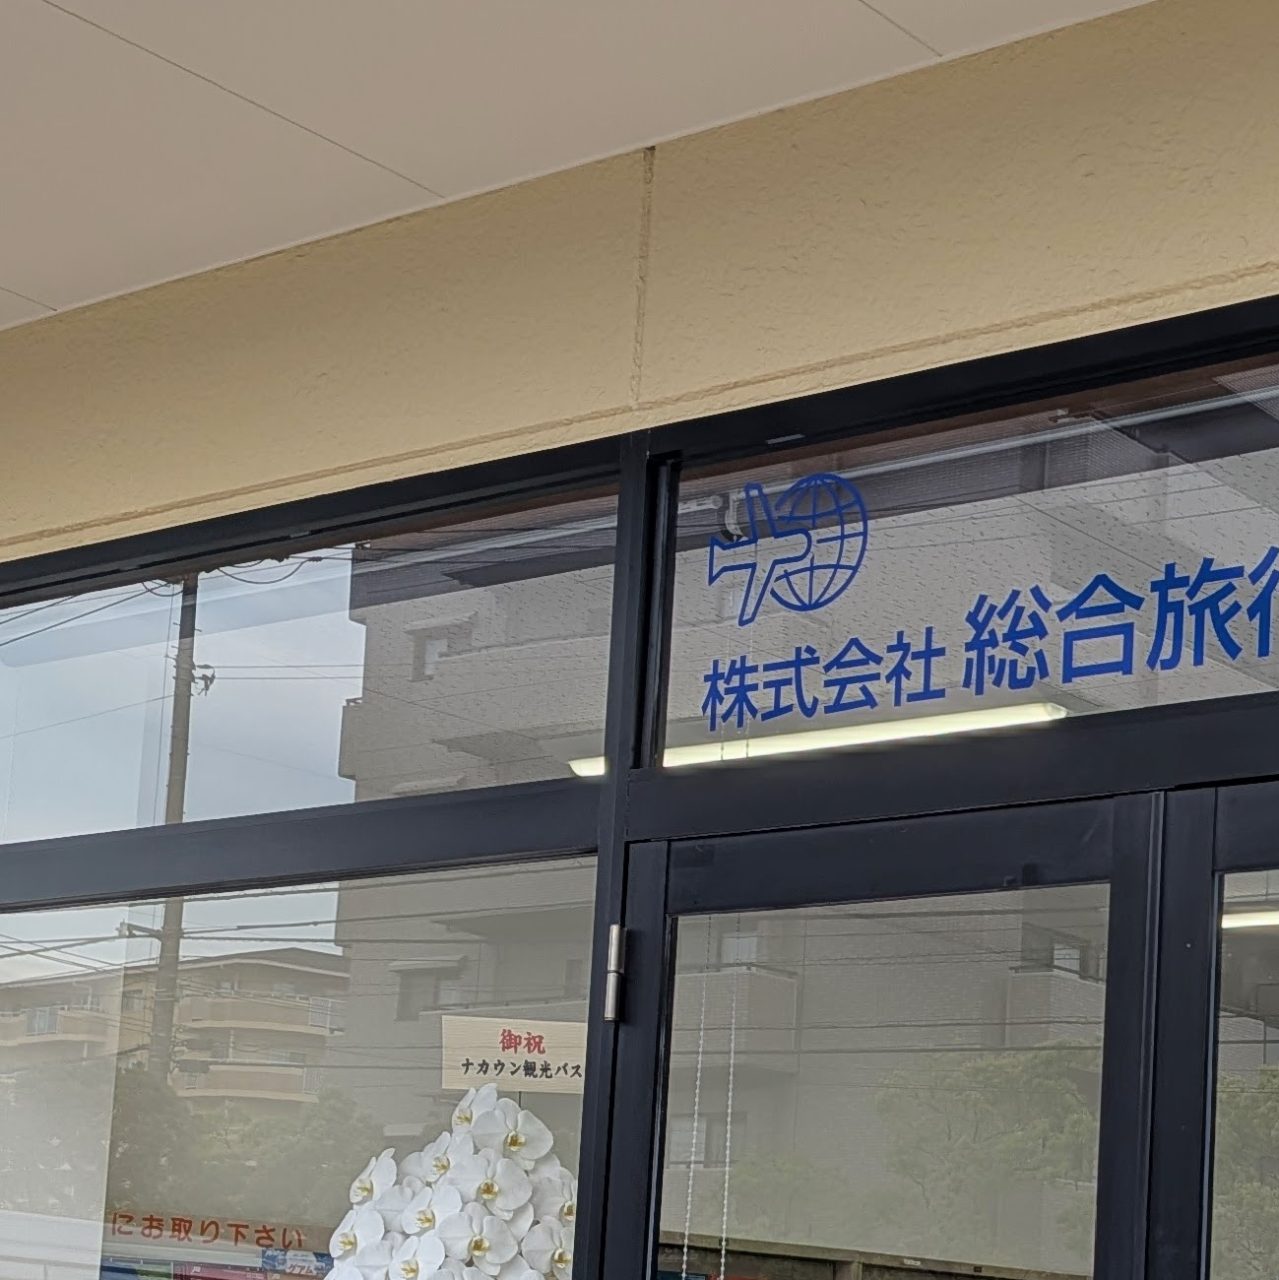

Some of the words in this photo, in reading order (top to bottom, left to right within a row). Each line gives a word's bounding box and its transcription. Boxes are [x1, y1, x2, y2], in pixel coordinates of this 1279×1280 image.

[701, 627, 947, 732] 株式会社
[498, 1028, 546, 1055] 御祝
[461, 1057, 583, 1079] ナカウン観光バス
